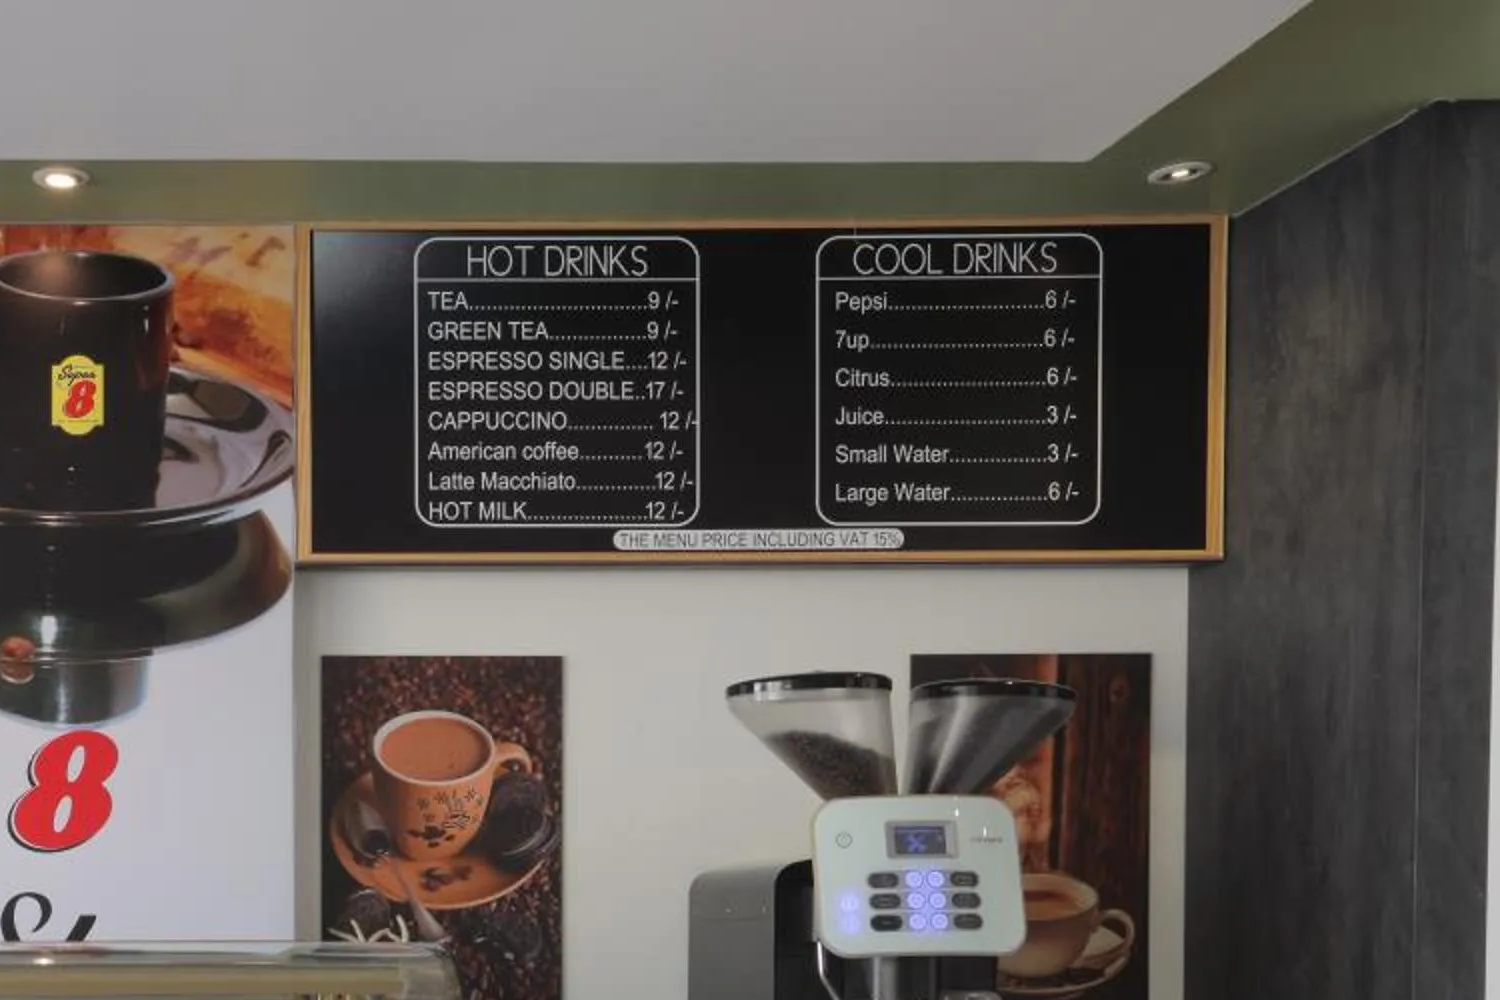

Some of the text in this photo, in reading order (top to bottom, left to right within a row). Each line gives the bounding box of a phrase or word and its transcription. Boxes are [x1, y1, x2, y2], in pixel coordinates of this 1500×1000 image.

[468, 245, 647, 276] HOT DRINKS
[853, 242, 1057, 275] COOL DRINKS
[428, 291, 468, 310] TEA
[648, 291, 660, 309] 9
[836, 292, 887, 314] Pepsi
[1046, 290, 1056, 309] 6
[428, 322, 501, 340] GREEN
[508, 322, 548, 340] TEA
[647, 321, 658, 339] 9
[836, 330, 869, 352] 7up
[1044, 328, 1056, 347] 6
[429, 351, 542, 370] ESPRESSO
[549, 351, 624, 370] SINGLE
[648, 351, 668, 369] 12
[836, 368, 890, 387] Citrus
[1047, 368, 1058, 385] 6
[62, 379, 97, 419] 8
[429, 381, 542, 400] ESPRESSO
[550, 381, 633, 400] DOUBLE
[646, 382, 665, 399] 17
[428, 411, 567, 430] CAPPUCCINO
[660, 412, 679, 430] 12
[836, 407, 884, 425] Juice
[1047, 405, 1058, 424] 3
[428, 442, 516, 460] American
[522, 441, 578, 460] coffee
[645, 441, 664, 460] 12
[836, 445, 887, 463] Small
[893, 445, 949, 462] Water
[1048, 444, 1058, 462] 3
[429, 472, 474, 490] Latte
[481, 472, 575, 490] Macchiato
[656, 472, 674, 490] 12
[836, 484, 888, 506] Large
[894, 483, 950, 501] Water
[1048, 482, 1060, 500] 6
[429, 502, 472, 520] HOT
[479, 502, 526, 520] MILK
[646, 501, 665, 520] 12
[620, 532, 899, 546] THE MENU PRICE INCLUDING VAT 15%
[8, 730, 119, 852] 8
